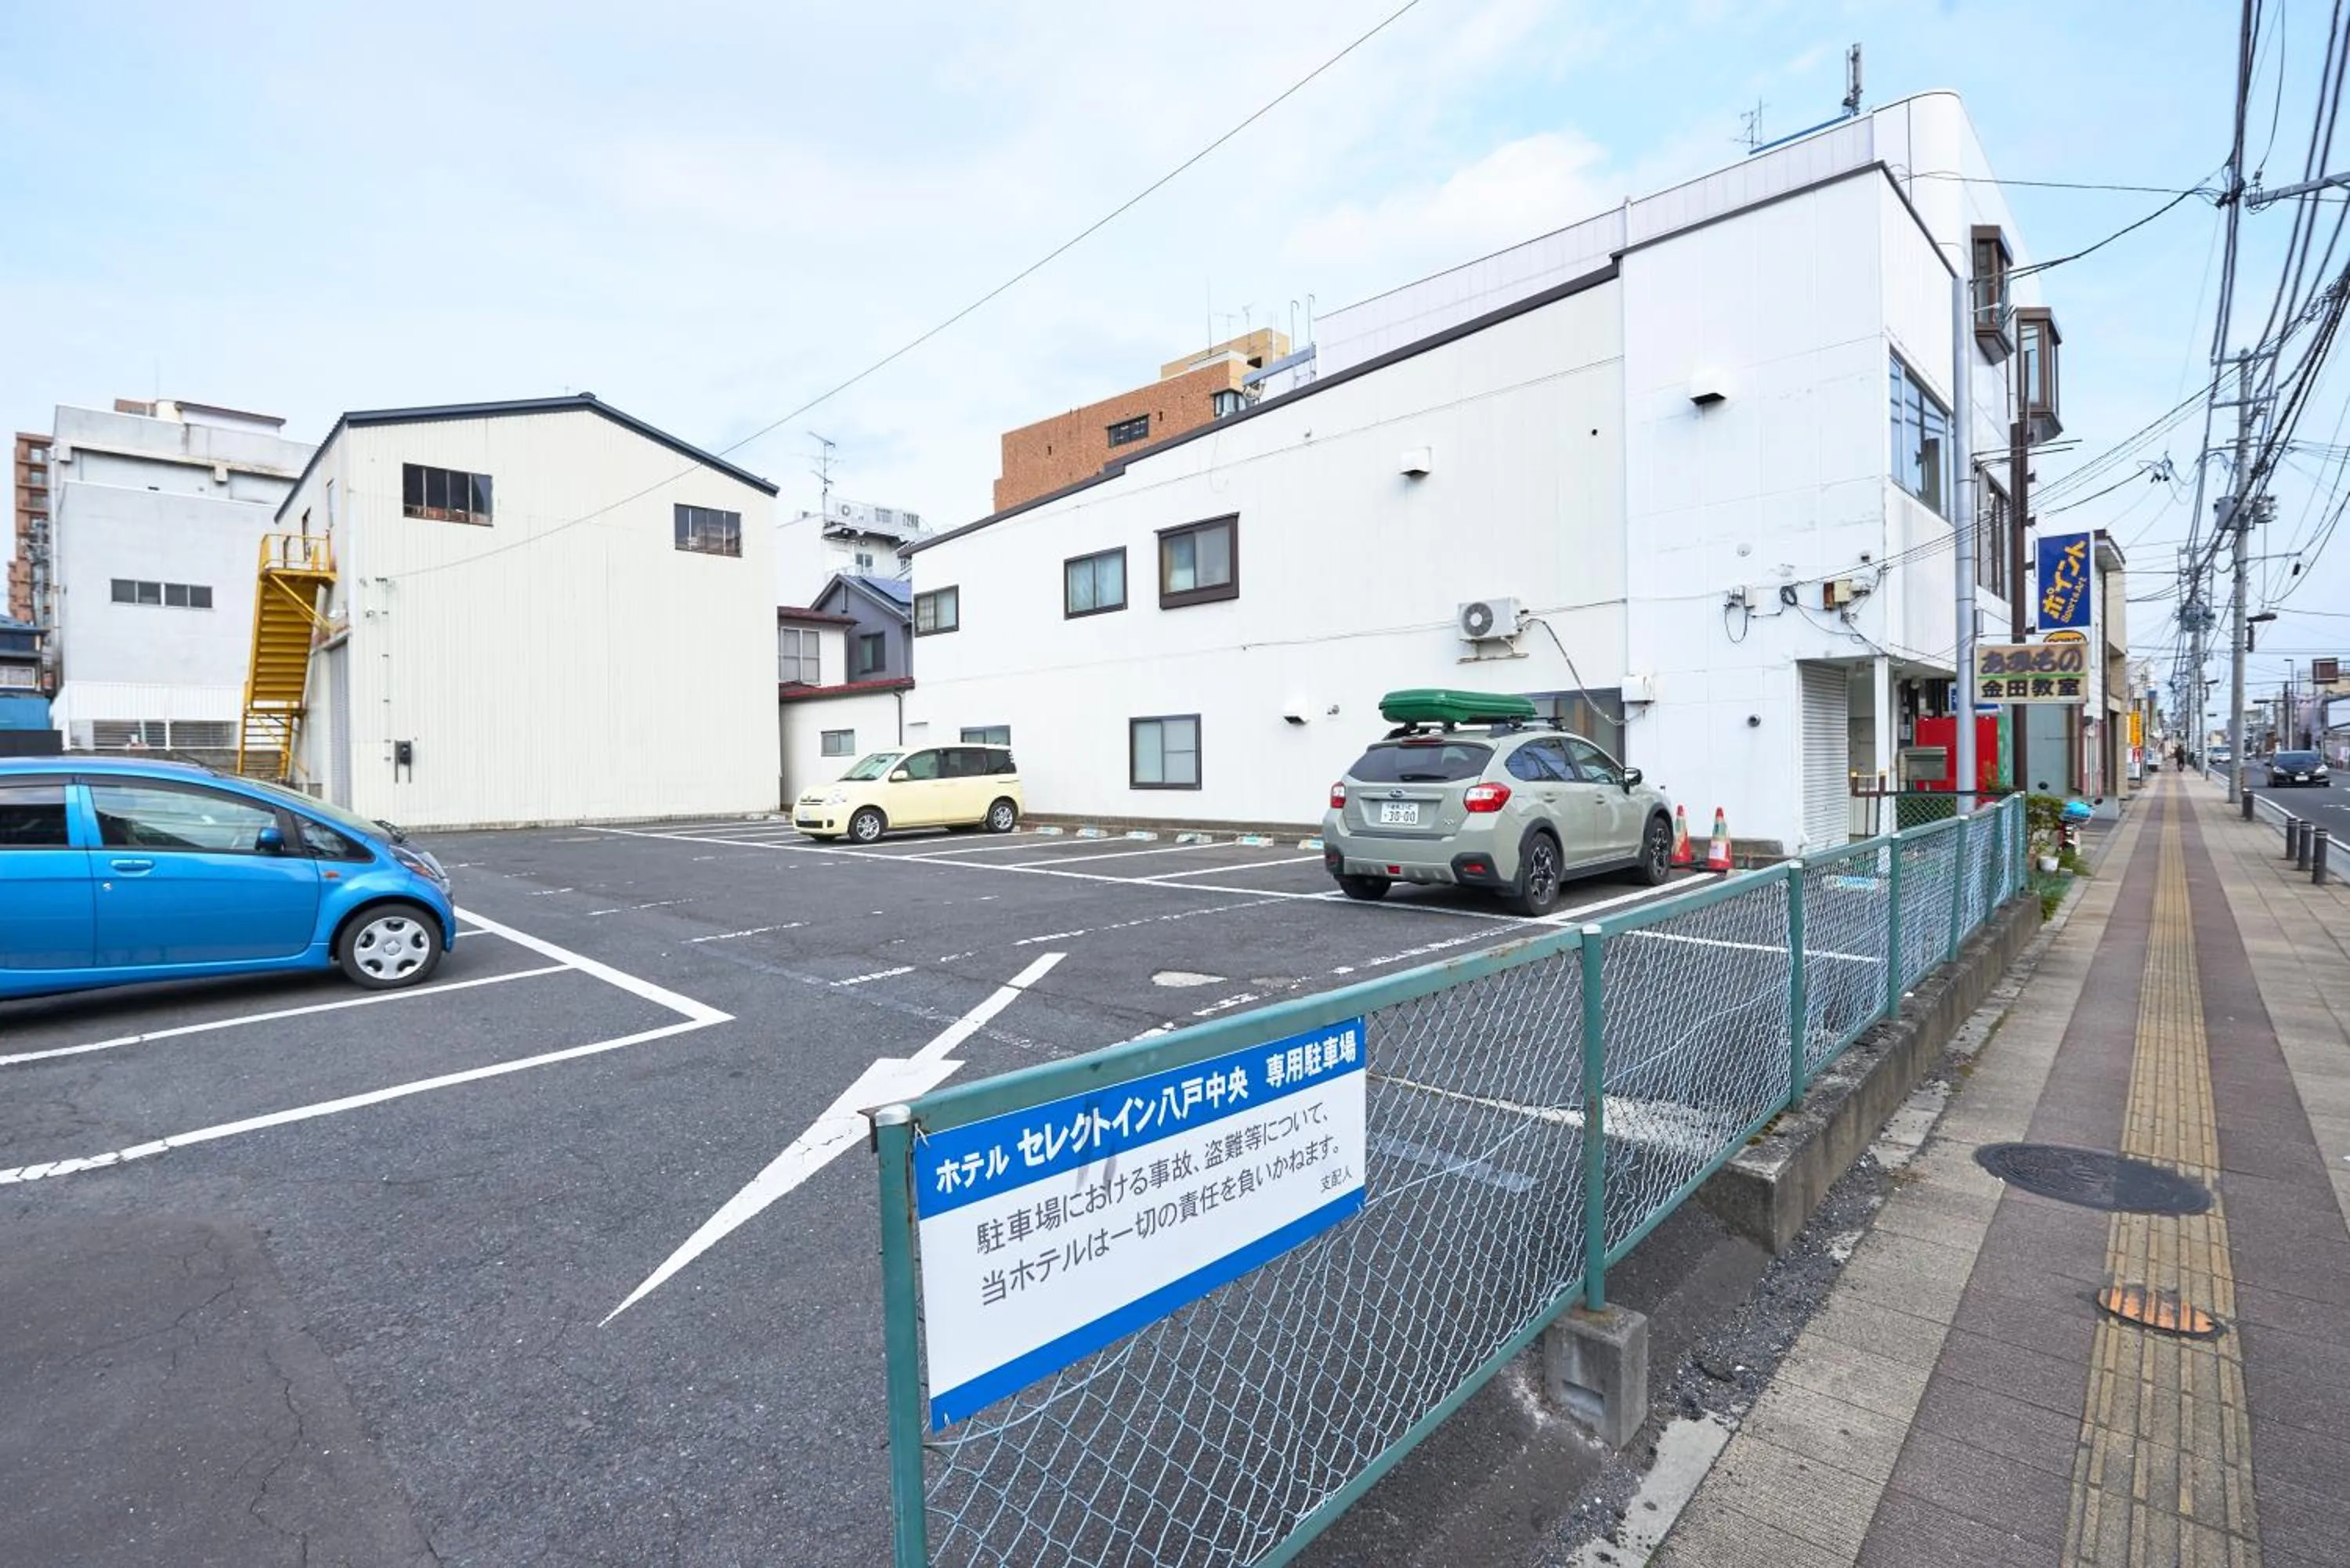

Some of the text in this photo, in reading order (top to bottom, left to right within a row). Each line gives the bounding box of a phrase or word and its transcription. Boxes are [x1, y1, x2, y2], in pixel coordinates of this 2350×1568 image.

[1981, 678, 2081, 698] 金田教室
[936, 1030, 1356, 1194] ホテル セレクトイン八戸中央 専用駐車場
[977, 1102, 1329, 1255] 駐車場における事故、盗難等について、
[1321, 1165, 1353, 1193] 支配人
[982, 1134, 1339, 1306] 当ホテルは一切の責任を負いかねます。
